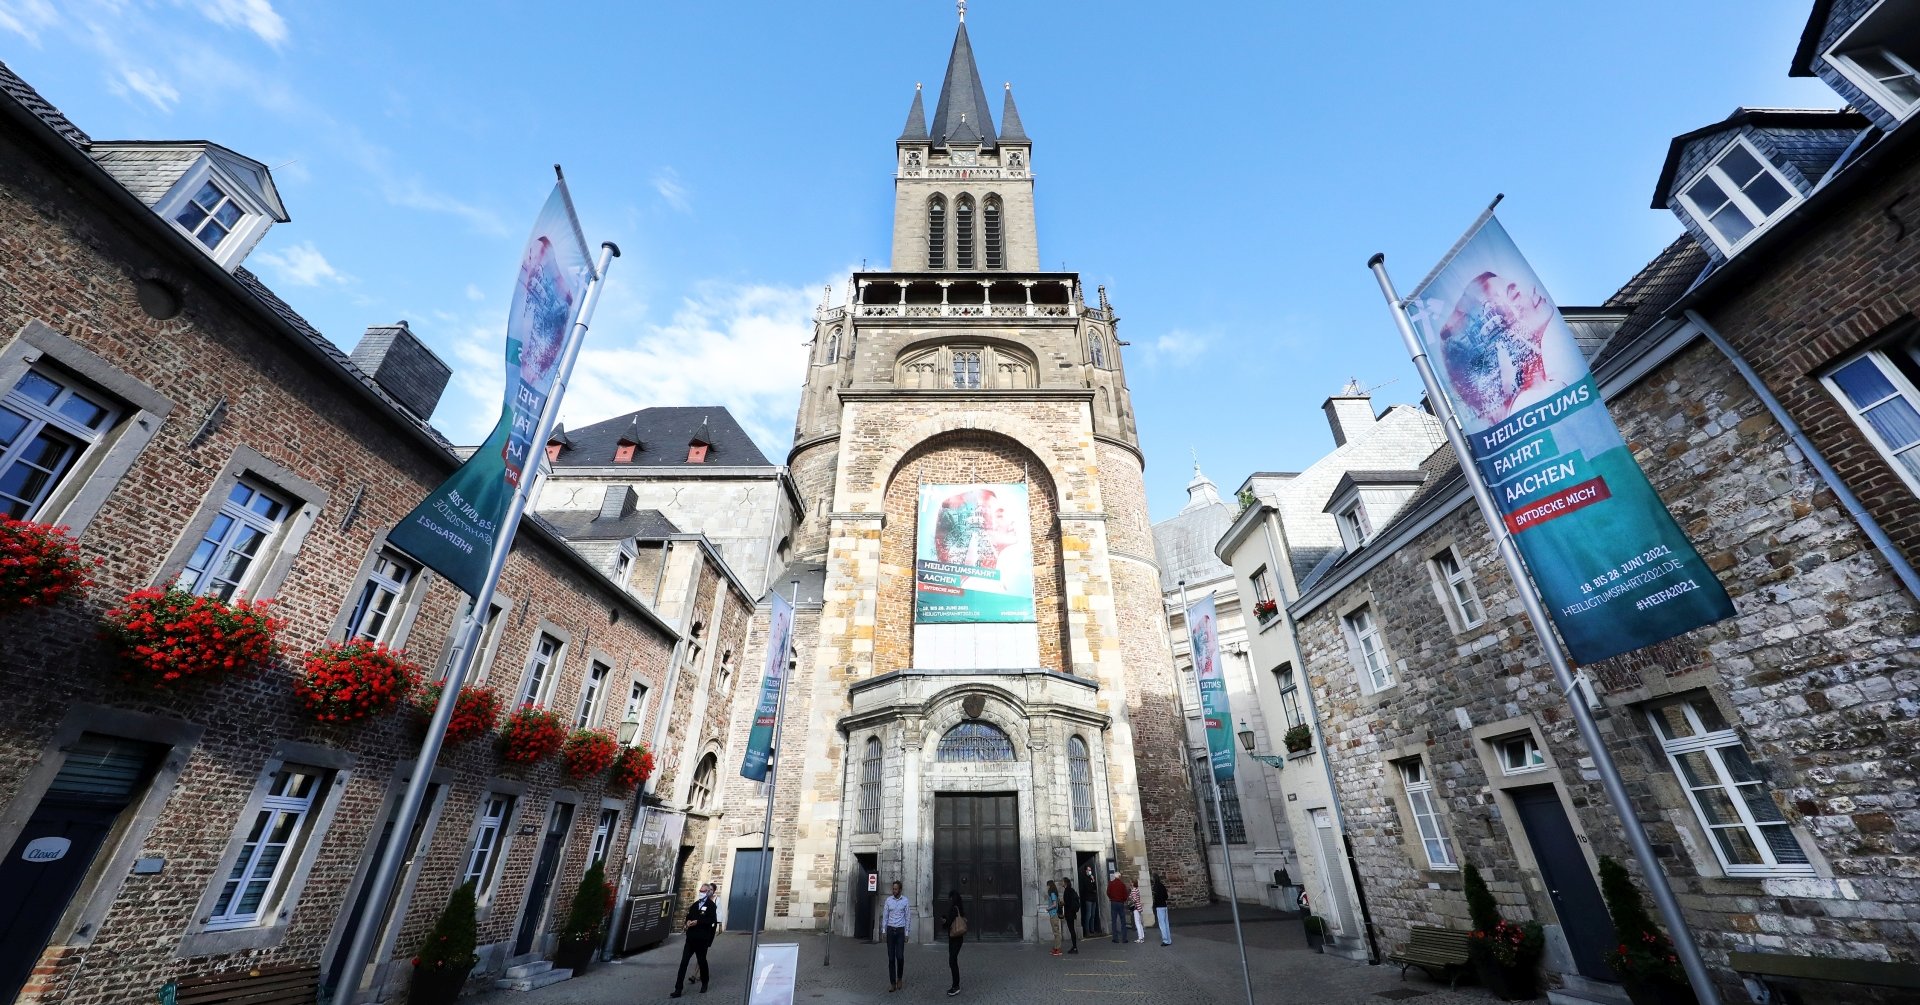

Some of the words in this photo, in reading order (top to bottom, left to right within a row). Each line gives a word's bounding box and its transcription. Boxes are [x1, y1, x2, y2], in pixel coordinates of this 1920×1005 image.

[1483, 384, 1590, 450] HEILIGTUMS
[1494, 438, 1544, 476] FAHRT
[1506, 460, 1576, 504] AACHEN
[1515, 500, 1566, 526] ENTDECKE
[1565, 485, 1597, 510] MICH
[923, 573, 957, 584] AACHEN
[924, 561, 997, 577] HEILIGTUMSFAHRT
[1580, 581, 1595, 595] 18.
[1594, 575, 1609, 590] BIS
[1607, 569, 1623, 582] 28.
[1620, 556, 1645, 575] JUNI
[1643, 544, 1673, 564] 2021
[1635, 578, 1701, 611] #HEIFA2021
[28, 848, 61, 859] Closed
[1577, 834, 1588, 844] 1b
